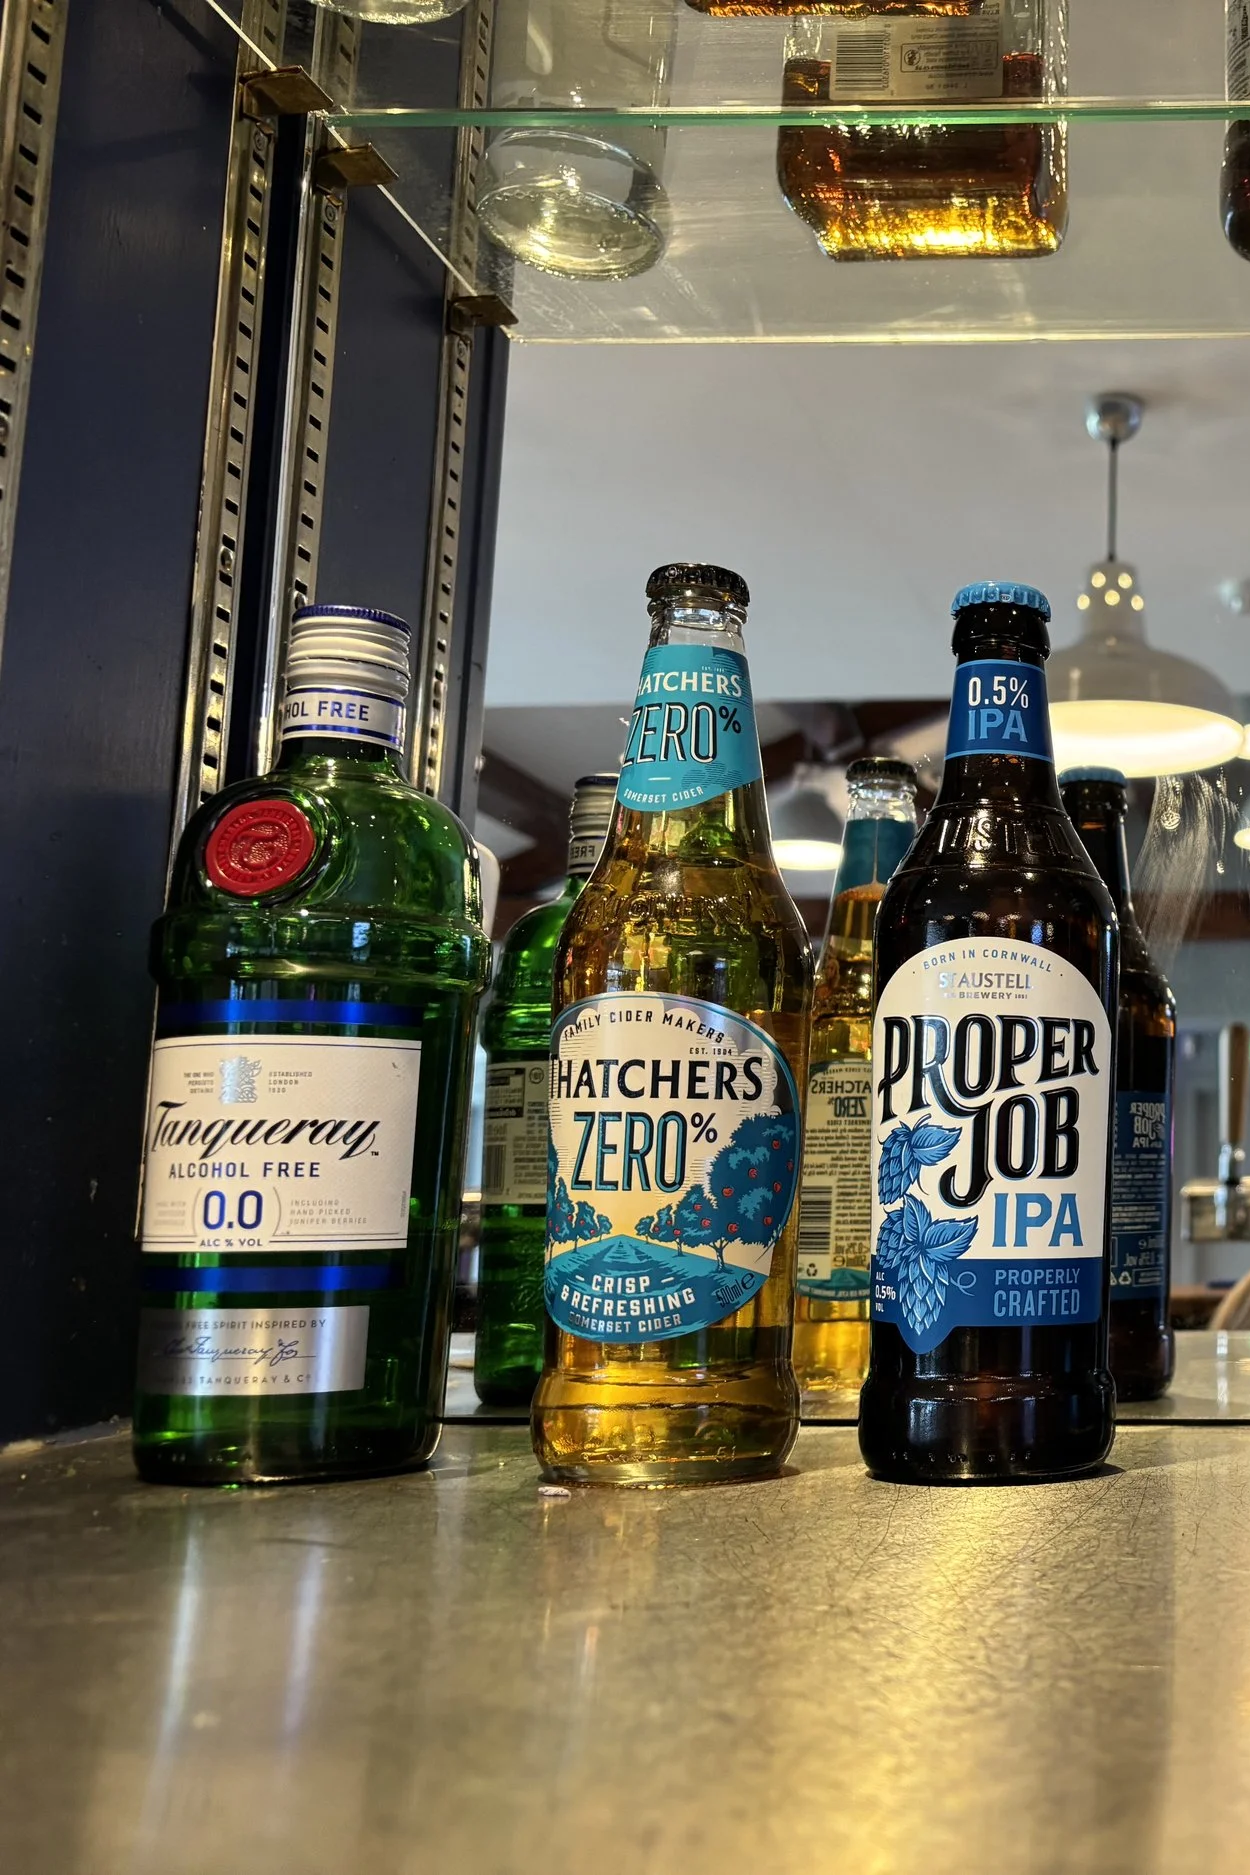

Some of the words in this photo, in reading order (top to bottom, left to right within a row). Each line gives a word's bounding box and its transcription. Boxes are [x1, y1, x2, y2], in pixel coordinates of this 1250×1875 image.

[968, 676, 1029, 709] 0.5%
[318, 701, 370, 721] FREE
[968, 708, 1028, 743] IPA
[624, 787, 666, 803] SOMERSET
[672, 786, 704, 802] CIDER
[923, 952, 956, 970] BORN
[962, 949, 976, 959] IN
[982, 948, 1052, 972] CORNWALL
[958, 972, 1033, 989] AUSTELL
[564, 1014, 602, 1041] FAMILY
[610, 1010, 653, 1023] CIDER
[662, 1013, 725, 1044] MAKERS
[689, 1047, 709, 1055] EST.
[713, 1048, 732, 1056] 1904
[878, 1013, 1100, 1124] PROPER
[151, 1100, 381, 1160] Tanqueray
[938, 1086, 1080, 1208] JOB
[168, 1162, 250, 1178] ALCOHOL
[263, 1162, 320, 1178] FREE
[203, 1190, 263, 1230] 0.0
[290, 1199, 339, 1207] INCLUDING
[318, 1208, 351, 1216] PICKED
[290, 1218, 328, 1226] JUNIPER
[331, 1217, 367, 1225] BERRIES
[992, 1193, 1083, 1247] IPA
[200, 1239, 220, 1247] ALC
[225, 1238, 233, 1247] %
[240, 1238, 263, 1247] VOL
[592, 1275, 651, 1294] CRISP
[876, 1272, 885, 1281] ALC
[995, 1268, 1081, 1285] PROPERLY
[571, 1287, 696, 1317] REFRESHING
[875, 1285, 896, 1301] 0.5%
[875, 1303, 884, 1312] VOL
[994, 1289, 1080, 1317] CRAFTED
[213, 1321, 247, 1330] SPIRIT
[251, 1320, 307, 1330] INSPIRED
[311, 1319, 327, 1328] BY
[569, 1311, 631, 1333] SOMERSET
[638, 1313, 682, 1332] CIDER
[200, 1375, 278, 1385] TANQUERAY
[284, 1375, 290, 1384] &
